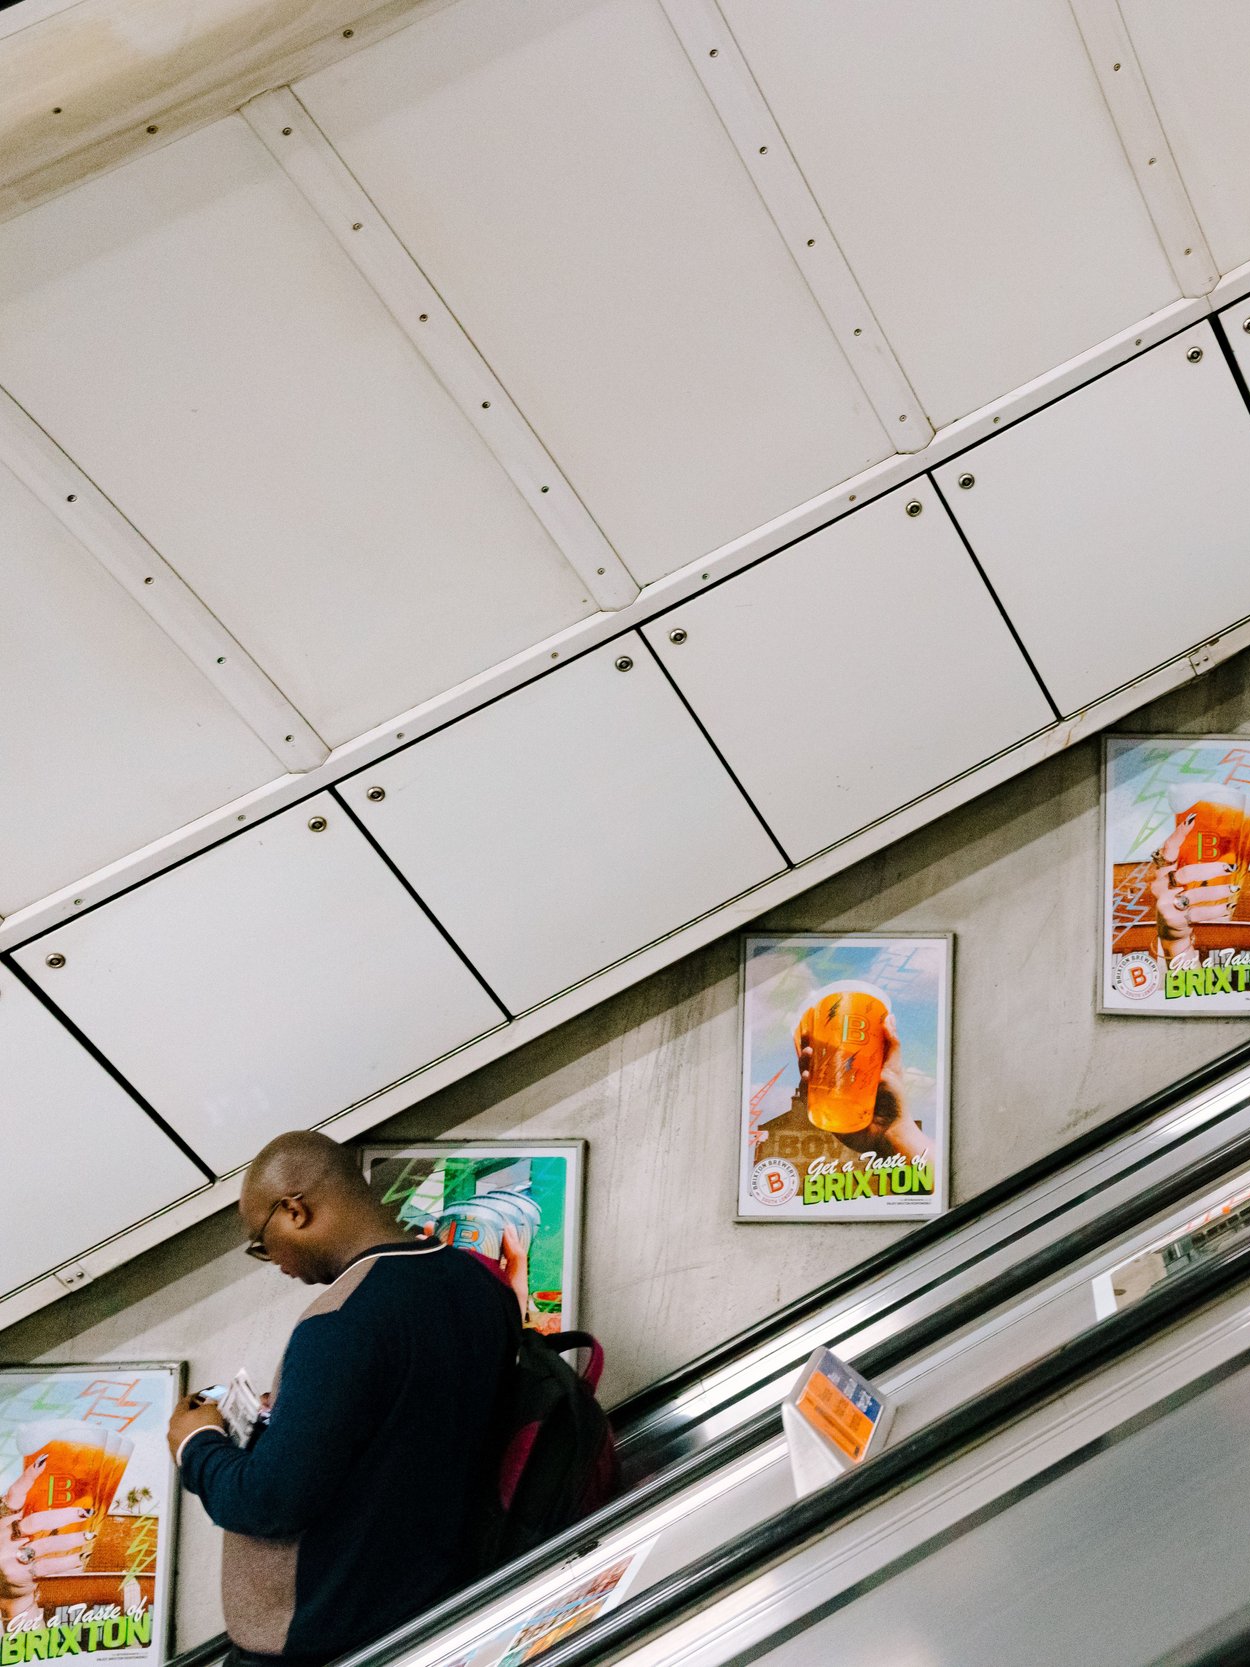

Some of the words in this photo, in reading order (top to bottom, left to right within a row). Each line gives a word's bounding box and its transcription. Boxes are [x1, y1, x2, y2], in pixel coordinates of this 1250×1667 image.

[1130, 967, 1147, 988] B
[1169, 953, 1198, 976] Get
[1202, 956, 1214, 968] a
[807, 1156, 837, 1182] Get
[842, 1161, 854, 1172] a
[859, 1151, 906, 1171] Taste
[911, 1147, 928, 1170] of
[765, 1172, 784, 1193] B
[803, 1164, 933, 1206] BRIXTON
[6, 1611, 44, 1641] Get
[47, 1614, 60, 1628] a
[68, 1603, 121, 1625] Taste
[127, 1596, 148, 1623] of
[0, 1612, 152, 1666] BRIXTON
